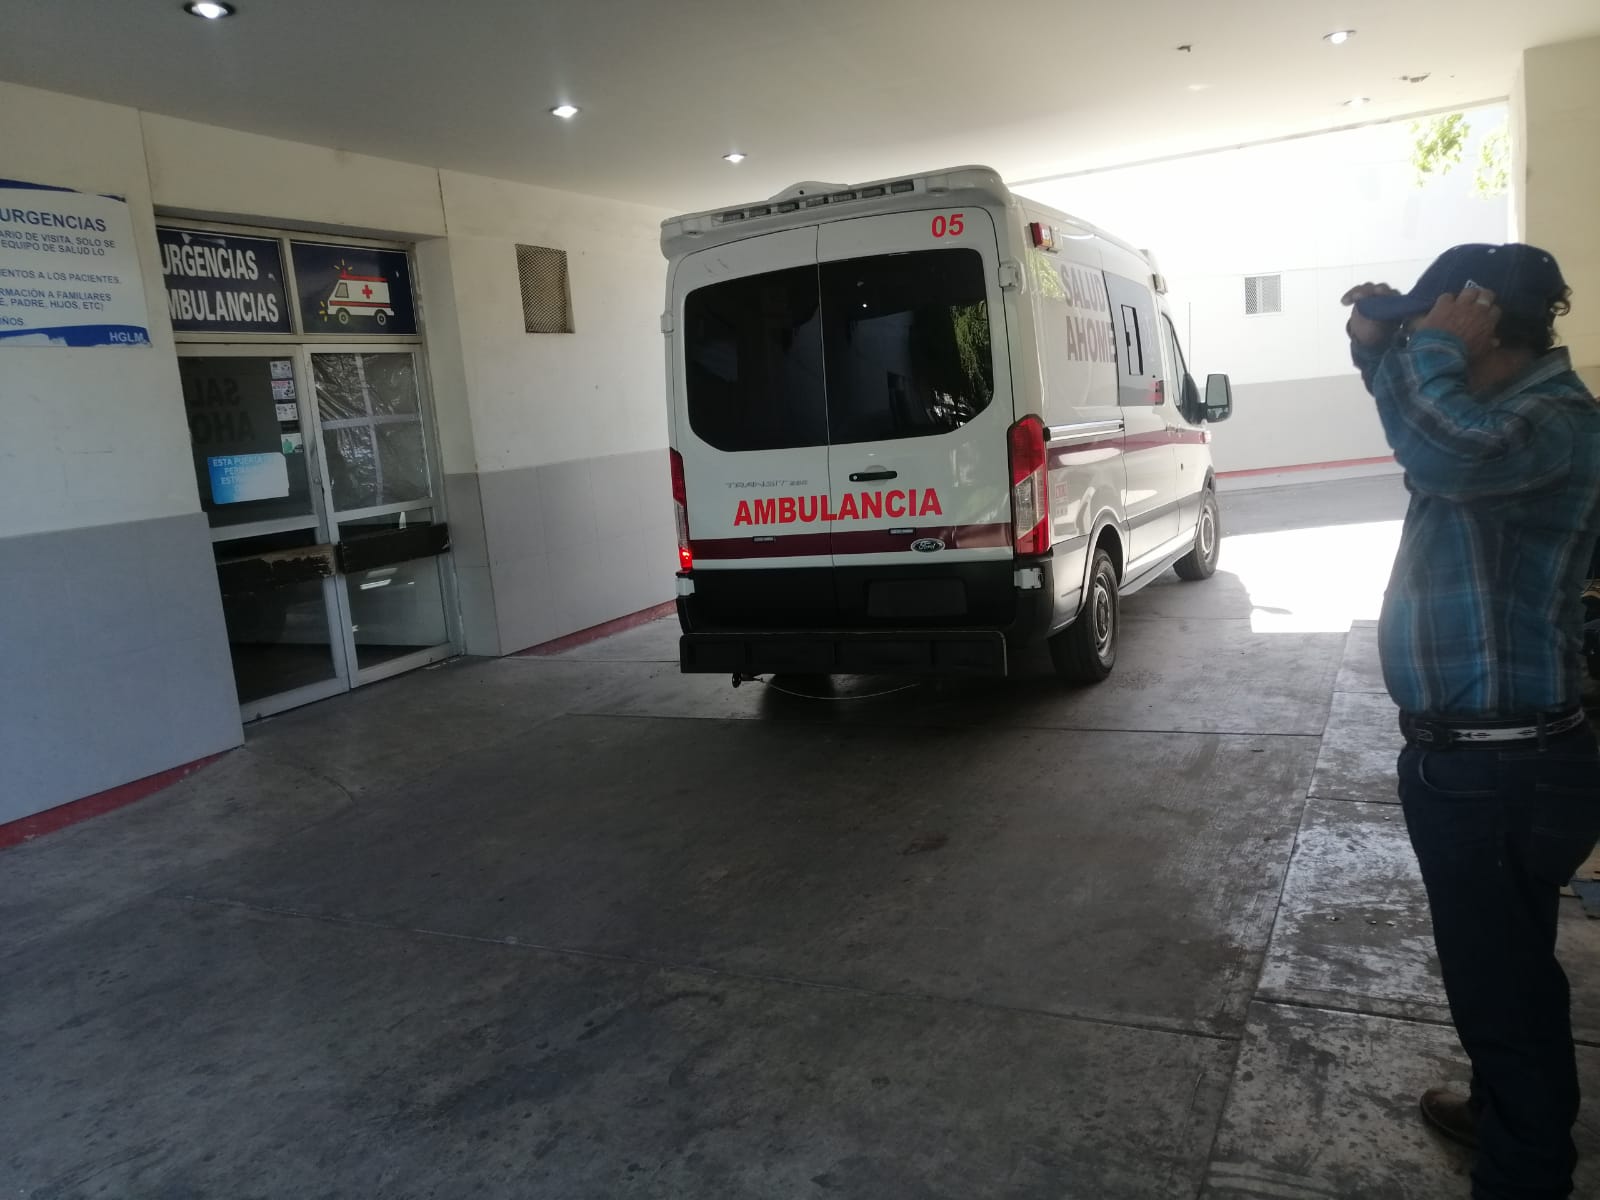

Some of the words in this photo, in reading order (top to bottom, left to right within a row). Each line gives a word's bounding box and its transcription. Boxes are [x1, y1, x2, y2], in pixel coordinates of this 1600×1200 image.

[0, 207, 107, 232] URGENCIAS
[931, 213, 965, 238] 05
[1, 239, 40, 251] EQUIPO
[42, 243, 56, 253] DE
[59, 245, 90, 255] SALUD
[92, 248, 105, 256] LO
[25, 231, 39, 242] DE
[76, 236, 101, 248] SOLO
[104, 239, 116, 249] SE
[161, 243, 259, 280] URGENCIAS
[38, 271, 45, 280] A
[47, 271, 67, 281] LOS
[1061, 263, 1106, 312] SALUD
[48, 290, 56, 299] A
[57, 290, 112, 302] FAMILIARES
[1065, 315, 1117, 363] AHOME
[733, 488, 943, 526] AMBULANCIA
